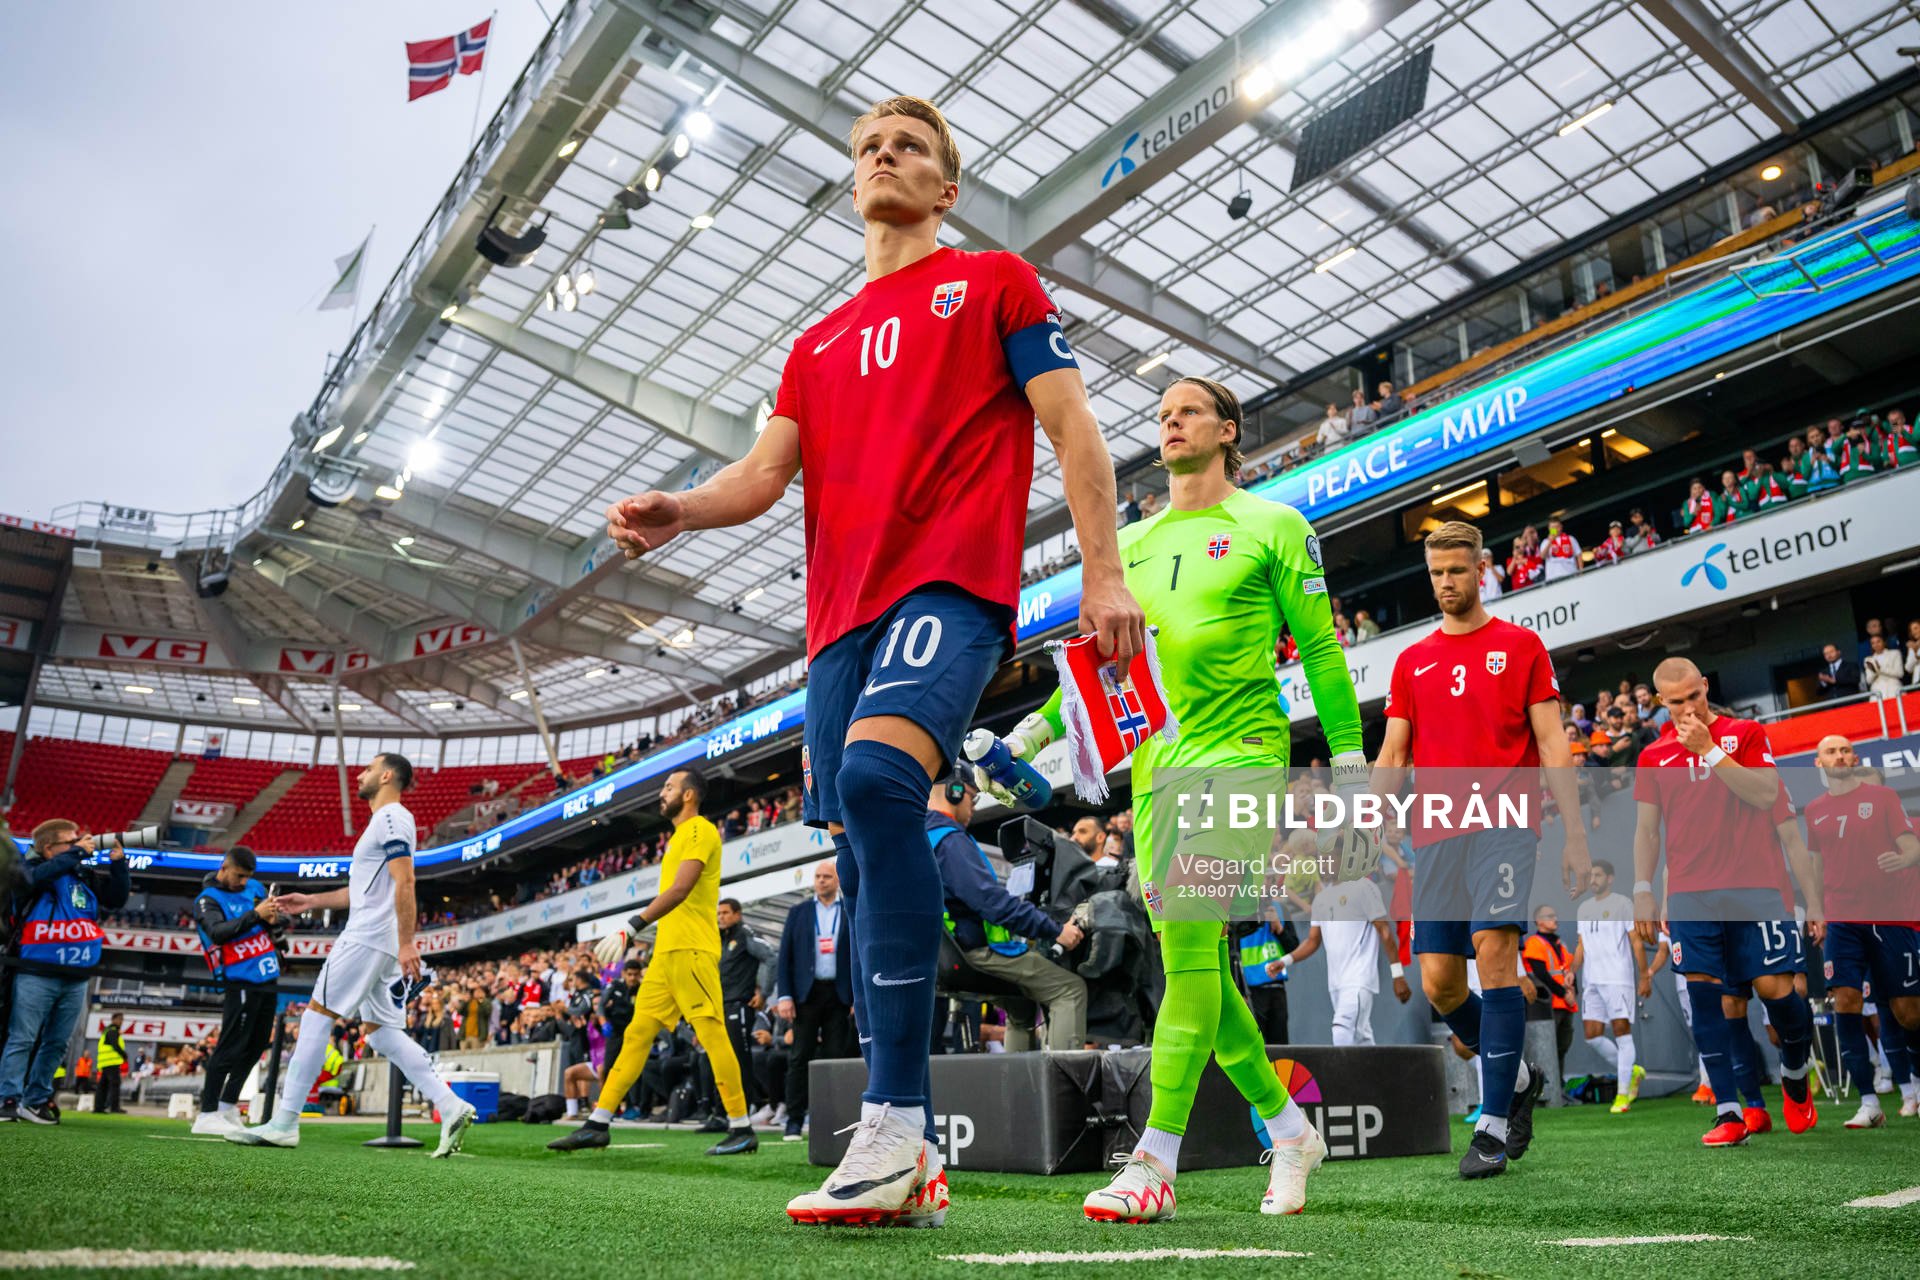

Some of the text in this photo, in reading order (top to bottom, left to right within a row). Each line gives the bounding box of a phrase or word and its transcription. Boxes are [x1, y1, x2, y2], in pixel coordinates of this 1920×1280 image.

[1142, 79, 1240, 161] telenor
[860, 316, 901, 377] 10
[1049, 330, 1073, 360] C
[1307, 437, 1407, 506] PEACE
[1442, 386, 1528, 450] МИР
[1728, 518, 1853, 574] telenor
[1171, 553, 1182, 591] 1
[1017, 591, 1053, 629] ИР
[99, 633, 207, 664] VG
[415, 624, 487, 657] VG
[880, 615, 943, 668] 10
[1450, 664, 1467, 697] 3
[706, 726, 744, 760] PEACE
[1836, 815, 1848, 838] 7
[298, 862, 339, 878] PEACE
[1497, 862, 1515, 898] 3
[102, 930, 165, 950] VG
[1757, 919, 1787, 951] 15
[56, 945, 92, 965] 124
